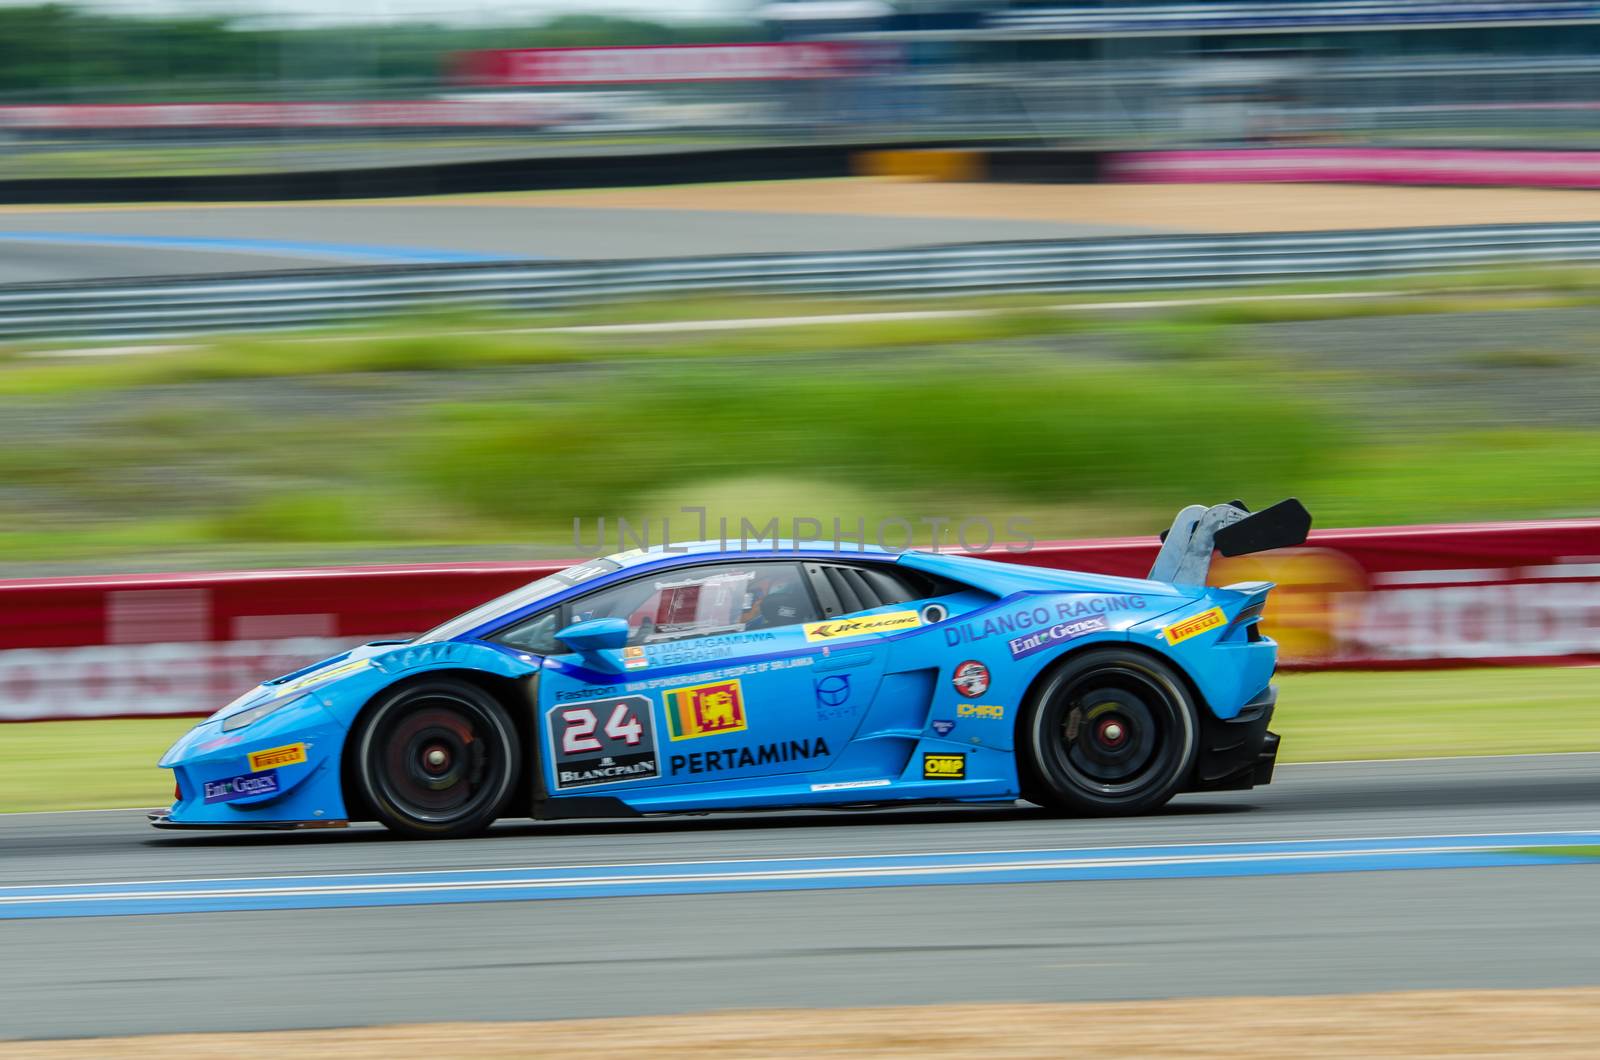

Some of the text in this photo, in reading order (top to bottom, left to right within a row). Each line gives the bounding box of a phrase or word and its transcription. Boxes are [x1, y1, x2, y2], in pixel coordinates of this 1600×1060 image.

[863, 616, 917, 629] RACING
[944, 595, 1147, 648] DILANGO RACING
[1009, 615, 1106, 656] EntoGenex
[1169, 610, 1221, 640] PIRELLI
[556, 685, 618, 700] Fastron
[561, 702, 644, 756] 24
[671, 736, 831, 776] PERTAMINA
[925, 759, 964, 773] OMP
[560, 760, 655, 783] BLANCPAIN
